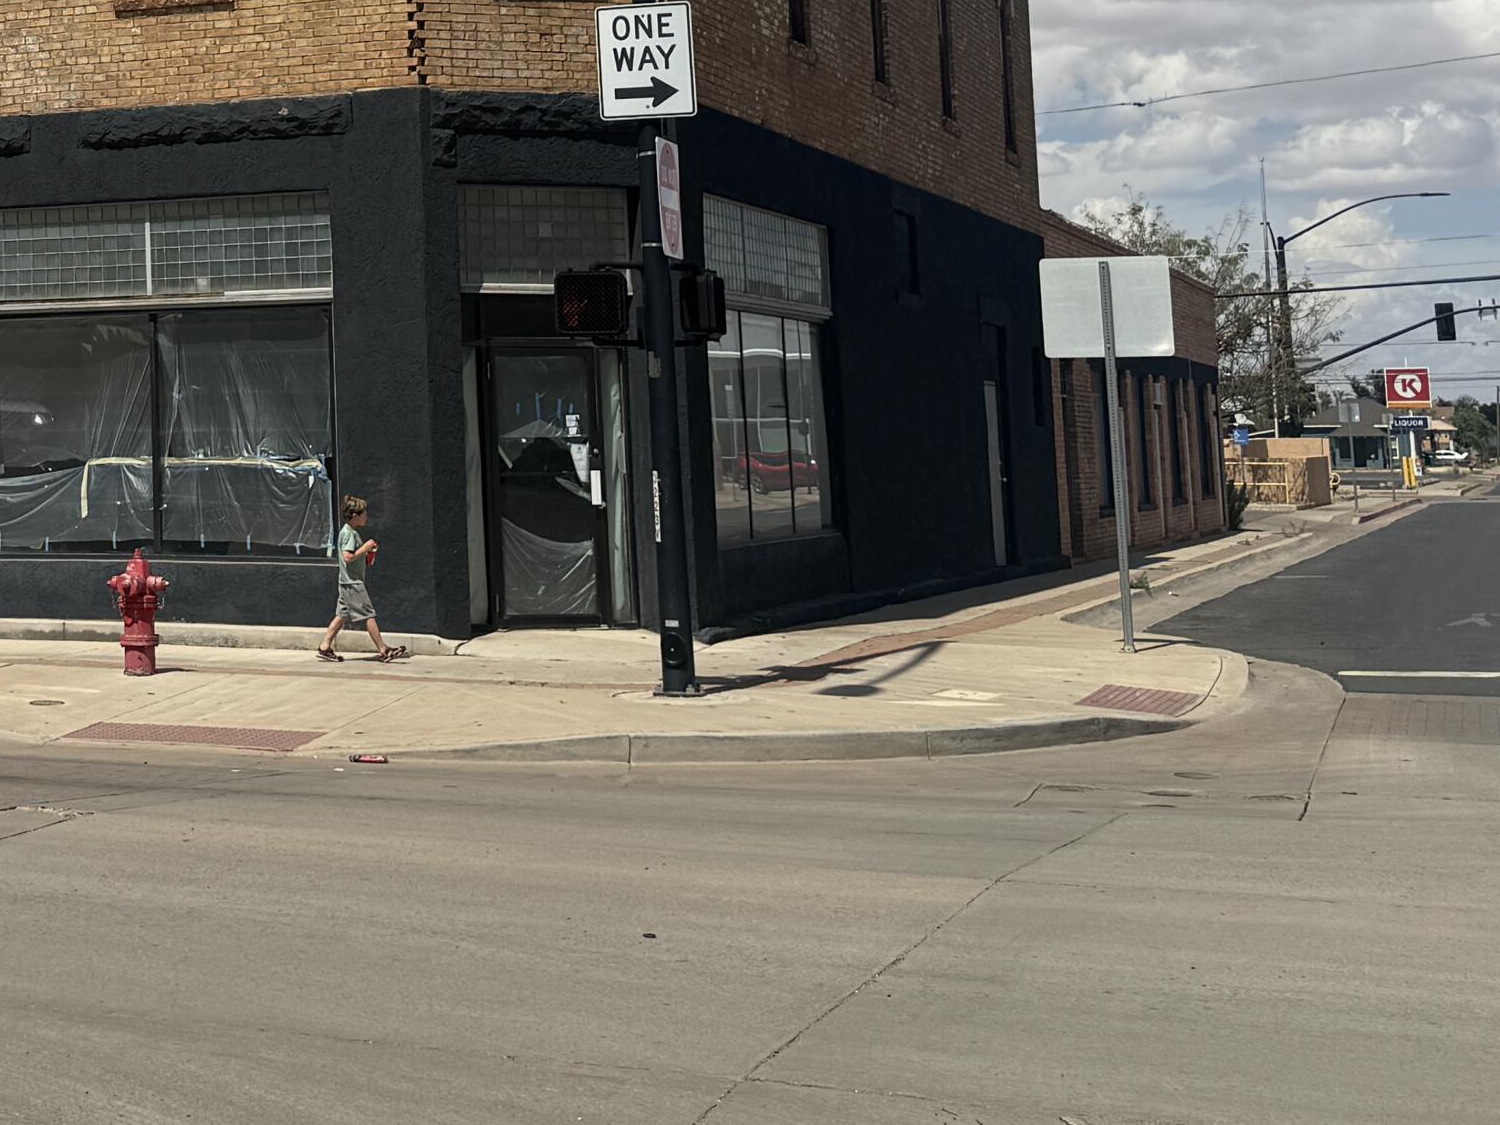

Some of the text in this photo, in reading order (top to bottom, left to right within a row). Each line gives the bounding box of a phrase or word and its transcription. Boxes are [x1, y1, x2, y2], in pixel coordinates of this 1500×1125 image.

[612, 13, 674, 41] ONE
[612, 44, 676, 72] WAY
[1401, 378, 1419, 396] K
[1394, 419, 1424, 427] LIQUOR
